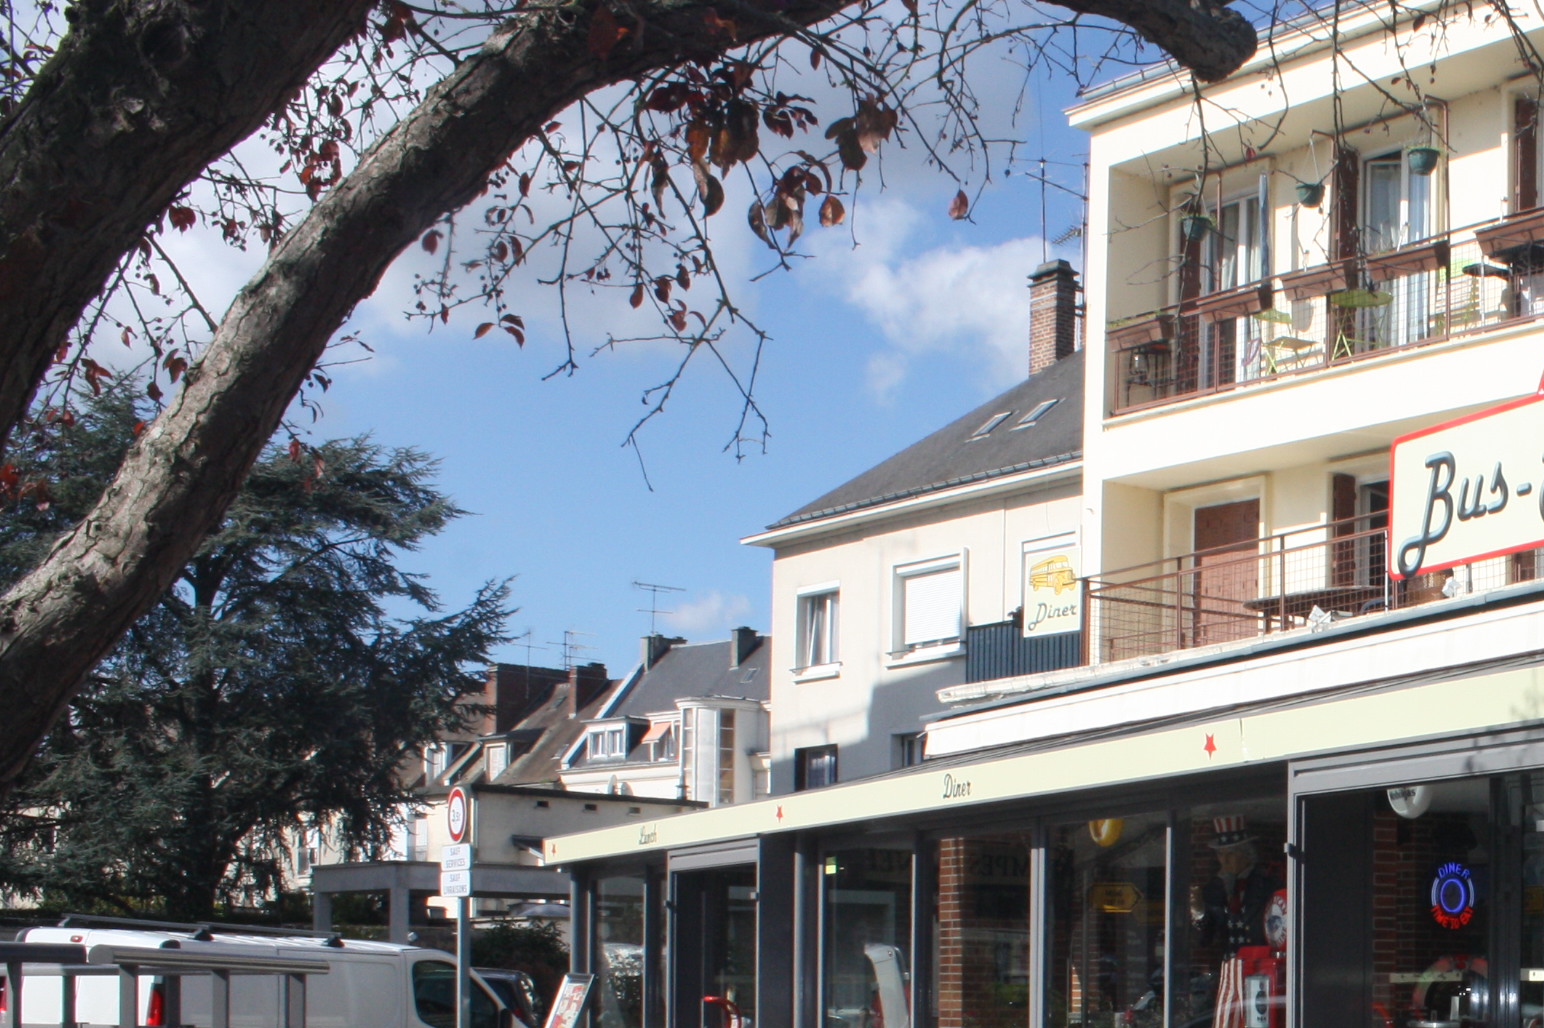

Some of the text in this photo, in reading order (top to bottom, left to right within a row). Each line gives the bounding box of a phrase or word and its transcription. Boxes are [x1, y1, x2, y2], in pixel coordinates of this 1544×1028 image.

[1027, 602, 1077, 631] Diner
[942, 773, 972, 799] Diner
[638, 823, 657, 845] Lunch
[449, 846, 461, 856] SAUF
[1437, 862, 1471, 879] DINER
